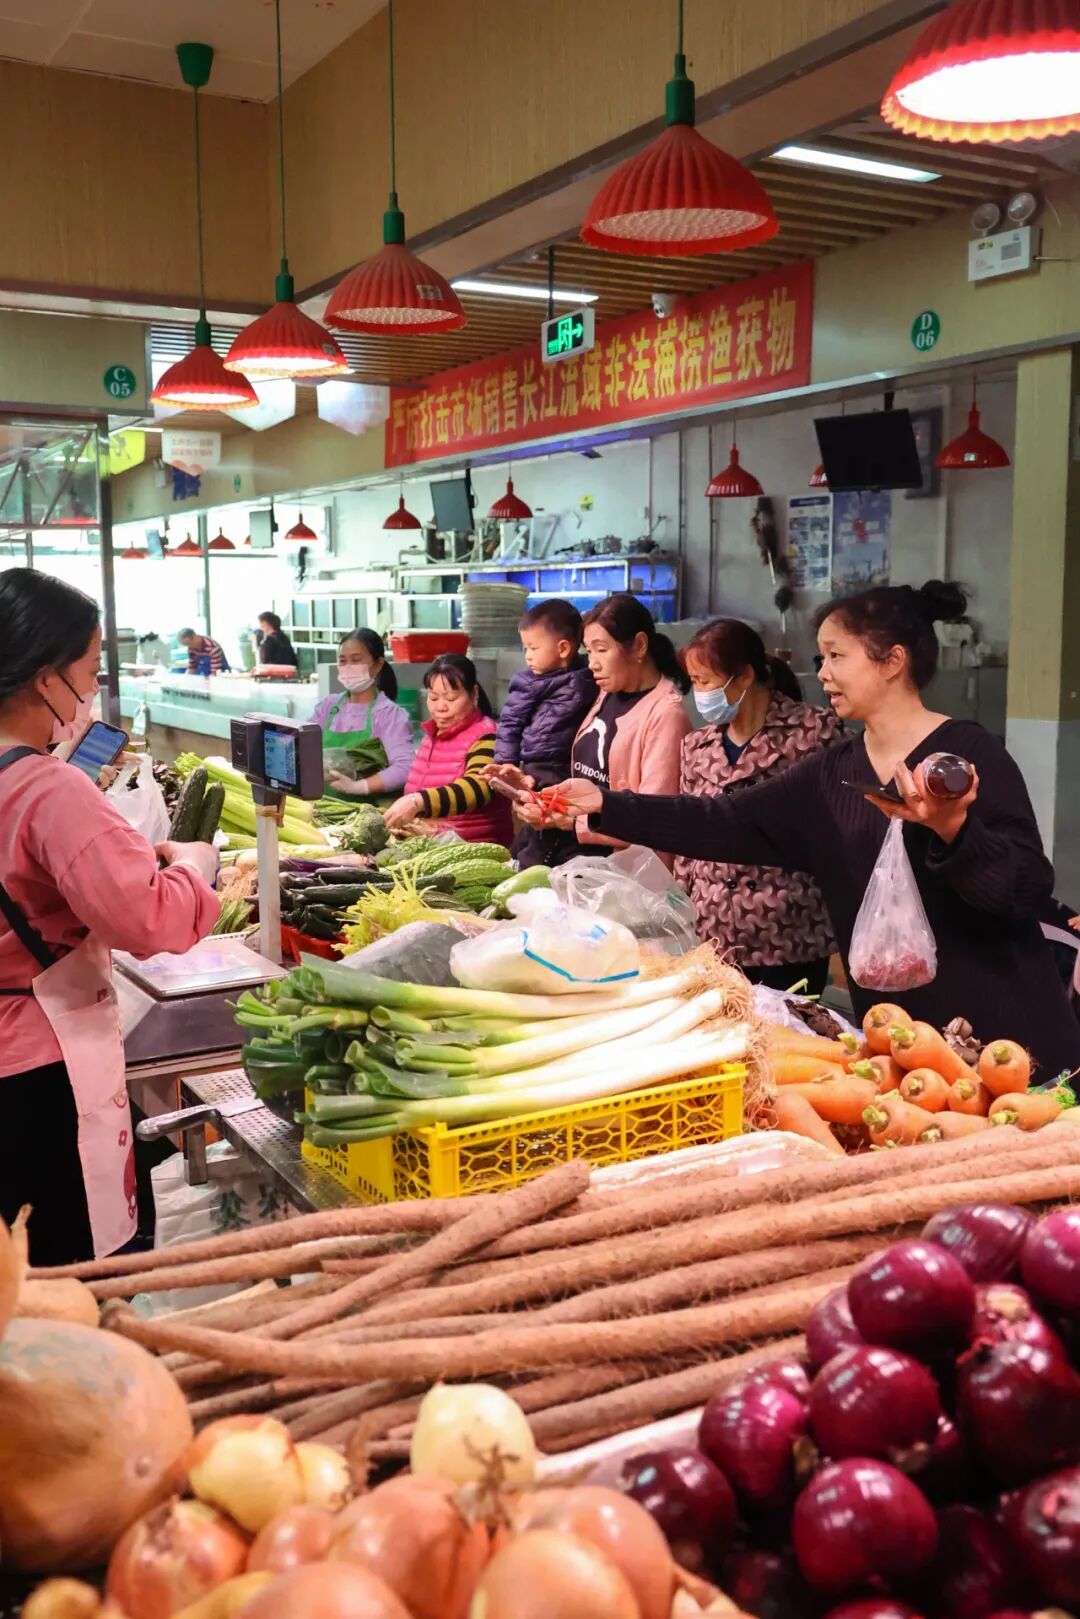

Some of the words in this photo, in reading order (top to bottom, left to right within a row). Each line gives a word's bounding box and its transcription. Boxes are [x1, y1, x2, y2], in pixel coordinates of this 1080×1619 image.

[921, 313, 932, 330] D
[916, 330, 935, 348] 06
[113, 367, 126, 381] C
[110, 382, 130, 396] 05
